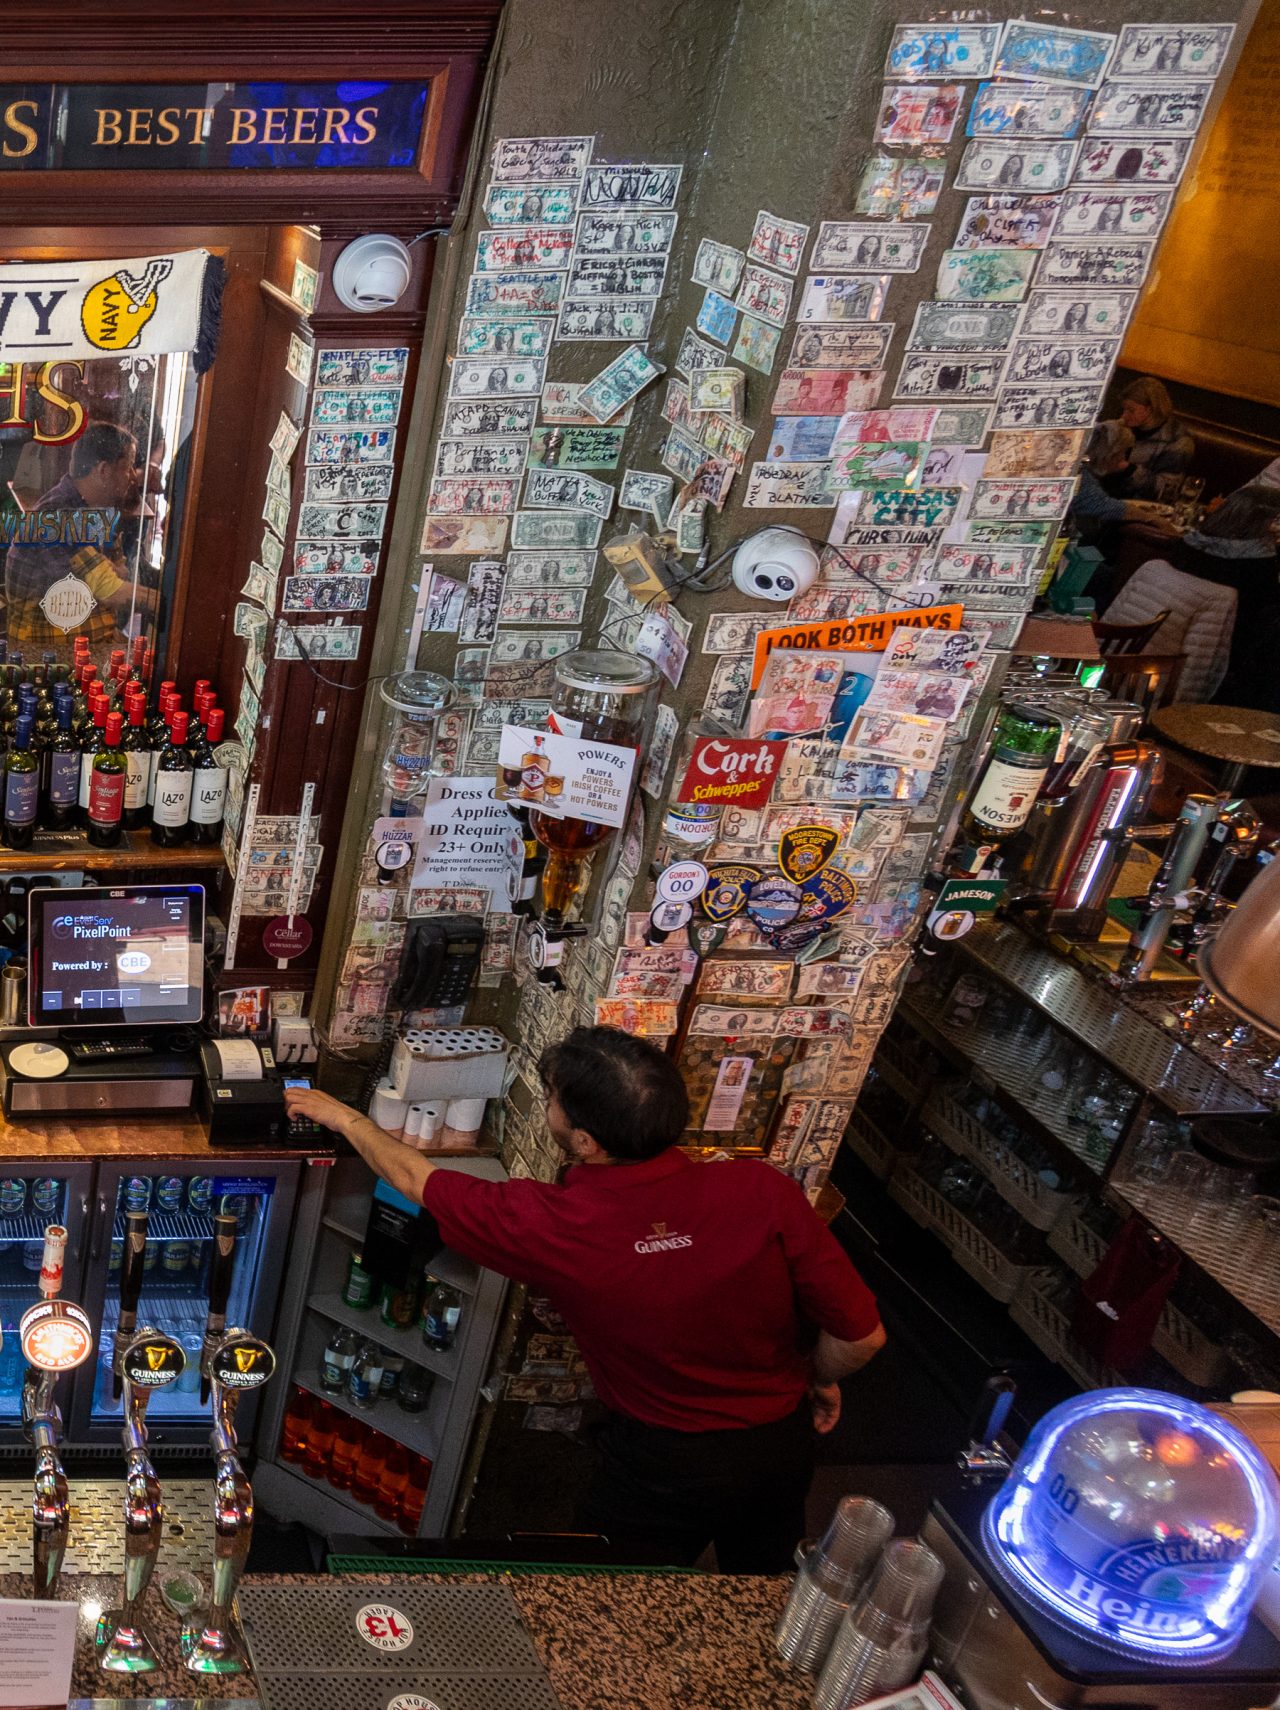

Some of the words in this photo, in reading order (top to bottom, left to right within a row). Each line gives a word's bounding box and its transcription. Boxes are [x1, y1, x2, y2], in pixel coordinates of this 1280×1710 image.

[92, 107, 215, 145] BEST
[226, 106, 379, 145] BEERS
[100, 287, 122, 342] NAVY
[766, 629, 824, 656] LOOK
[828, 621, 885, 647] BOTH
[577, 749, 627, 769] POWERS
[696, 740, 775, 776] Cork
[586, 767, 607, 777] ENJOY
[726, 771, 738, 784] &
[581, 775, 614, 787] POWERS
[440, 787, 483, 800] Dress
[571, 780, 592, 791] IRISH
[593, 785, 622, 798] COFFEE
[587, 791, 597, 799] OR
[690, 779, 762, 802] Schweppes
[570, 795, 585, 806] HOT
[586, 798, 618, 812] POWERS
[451, 806, 509, 821] Applies
[382, 831, 413, 841] HUZZAR
[429, 824, 449, 836] ID
[438, 841, 466, 853] 23+
[470, 841, 505, 856] Only
[792, 837, 808, 847] FIRE
[422, 857, 472, 865] Management
[428, 865, 448, 873] right
[818, 880, 843, 904] POLICE
[945, 888, 993, 900] JAMESON
[755, 915, 786, 926] POLICE
[73, 924, 132, 938] PixelPoint
[52, 960, 87, 971] Powered
[88, 960, 102, 971] by
[120, 956, 148, 968] CBE
[634, 1234, 693, 1254] GUINNESS
[130, 1368, 176, 1379] GUINNESS
[219, 1369, 266, 1381] GUINNESS
[363, 1606, 396, 1619] LAGER
[364, 1615, 404, 1638] 13
